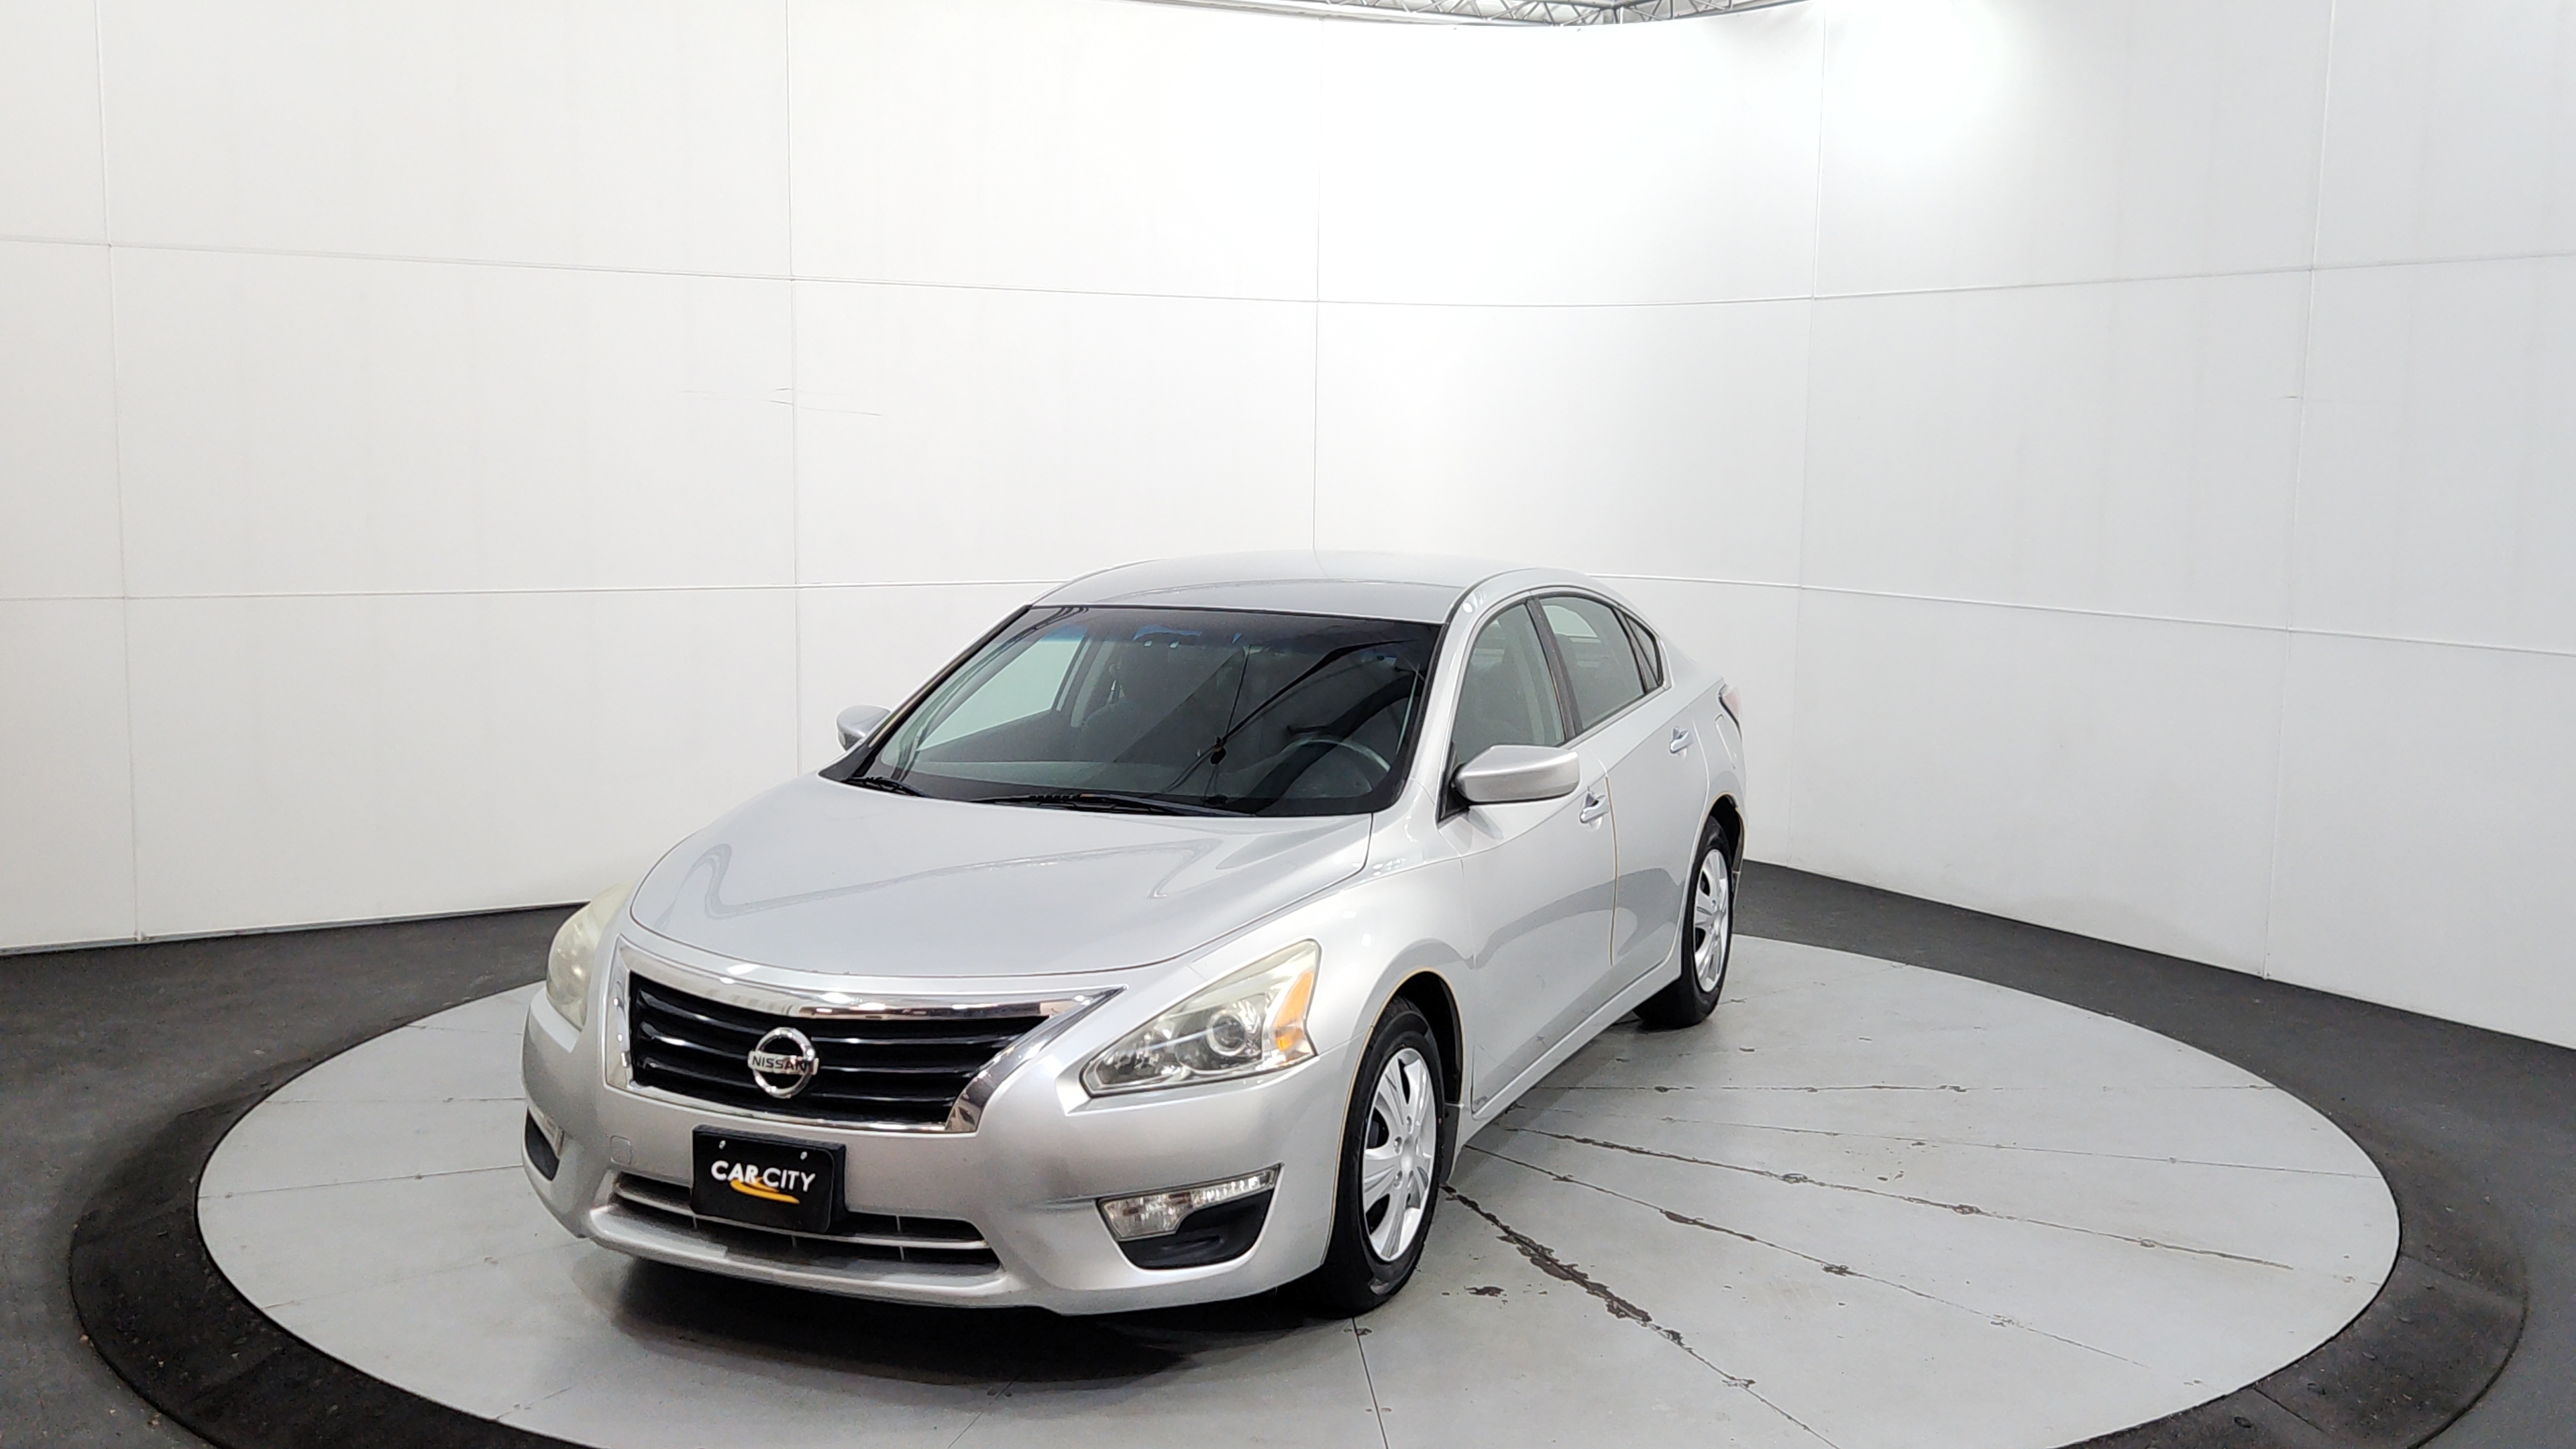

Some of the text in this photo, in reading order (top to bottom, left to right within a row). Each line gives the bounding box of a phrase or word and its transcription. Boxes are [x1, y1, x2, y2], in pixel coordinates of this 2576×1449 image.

[751, 1055, 808, 1073] NISSAN
[710, 1160, 816, 1193] CAR CITY
